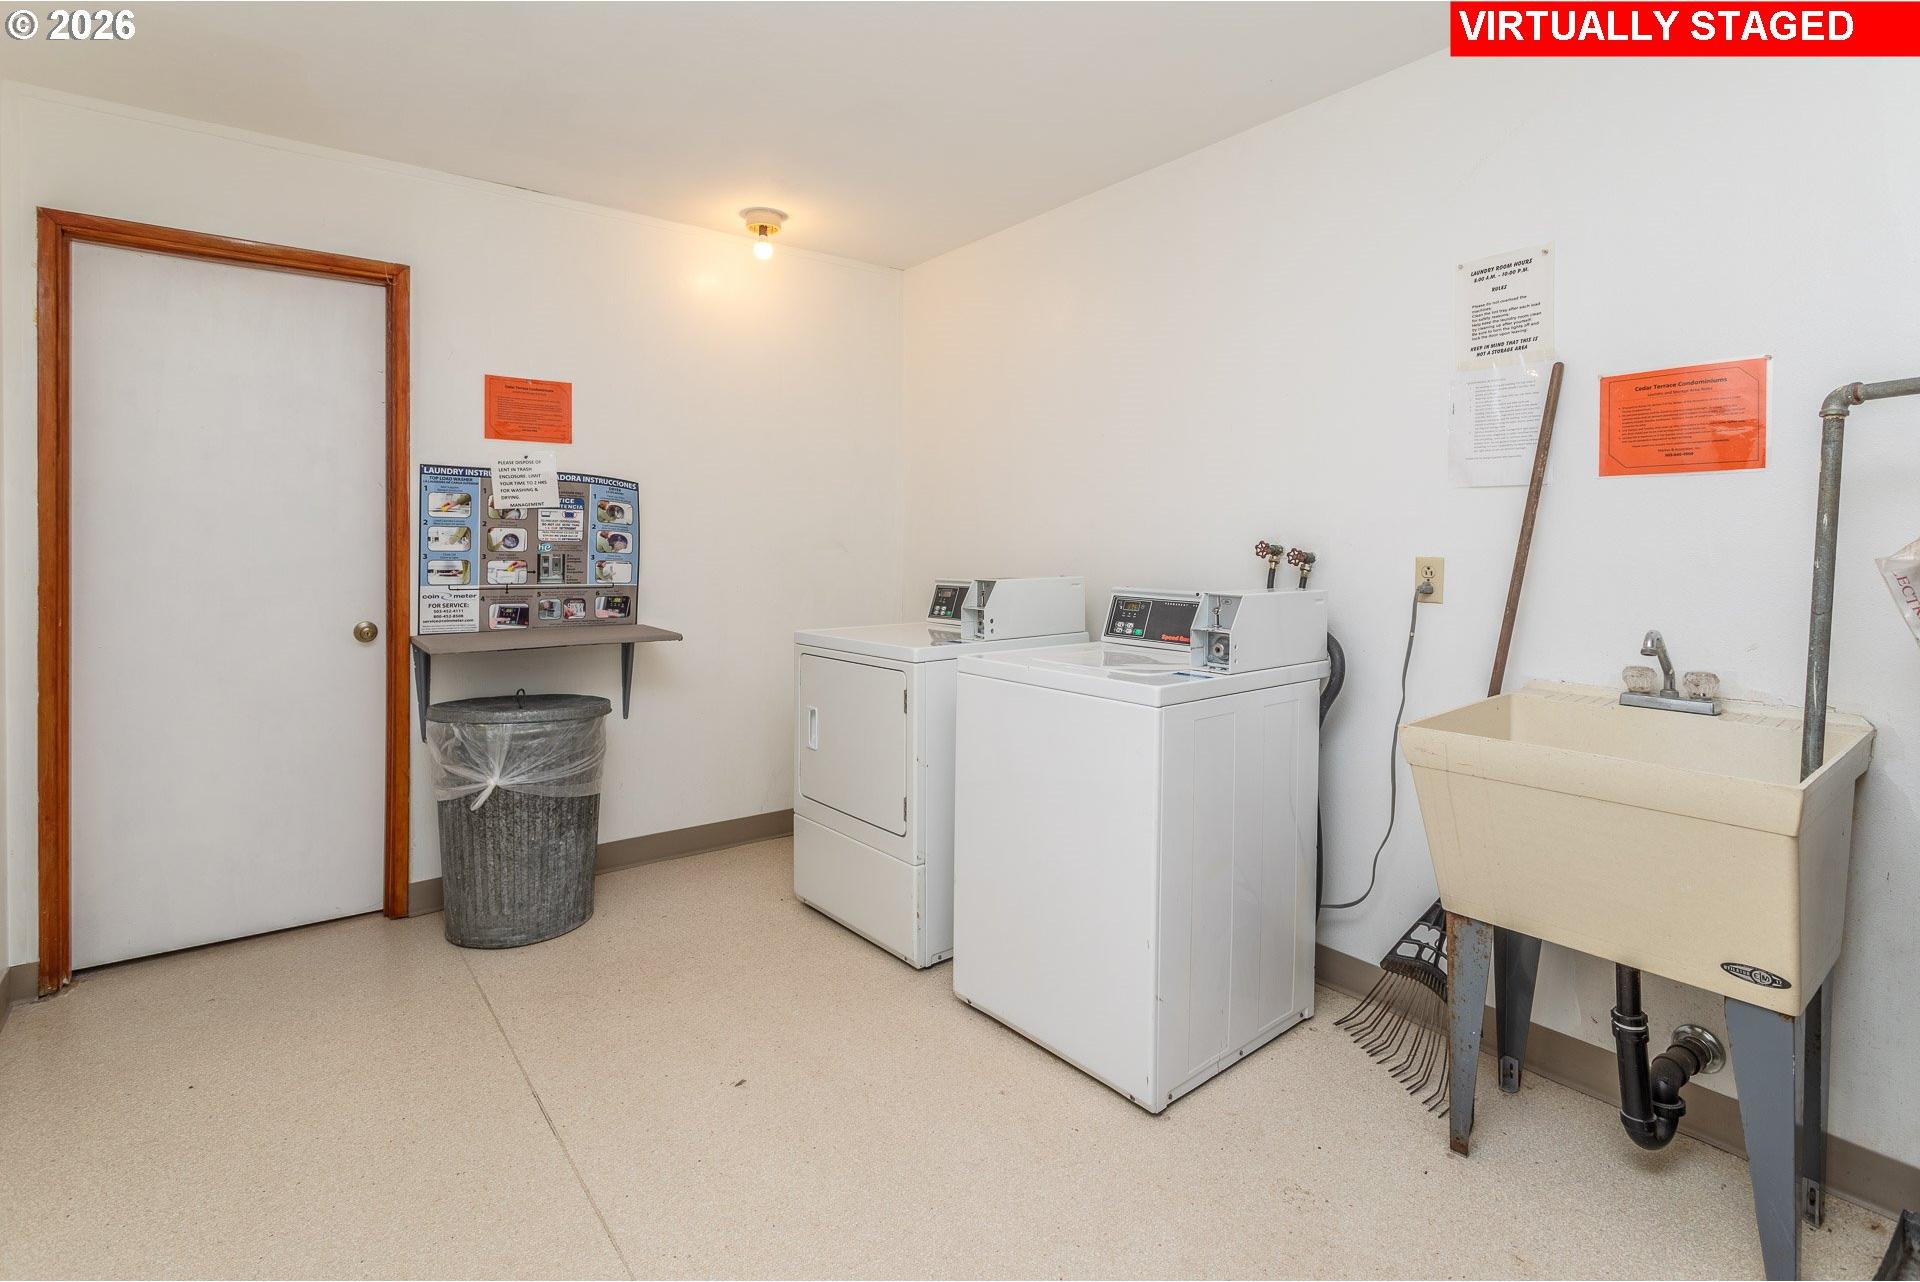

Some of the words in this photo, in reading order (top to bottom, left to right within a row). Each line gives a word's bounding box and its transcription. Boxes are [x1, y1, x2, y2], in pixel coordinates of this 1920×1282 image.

[1470, 266, 1494, 276] LAUNDRY
[1514, 258, 1533, 267] HOURS
[1492, 284, 1508, 292] RULES
[1491, 346, 1514, 354] STORAGE
[1678, 376, 1728, 388] Condominiums
[424, 466, 464, 474] LAUNDRY
[582, 476, 637, 490] INSTRUCCIONES
